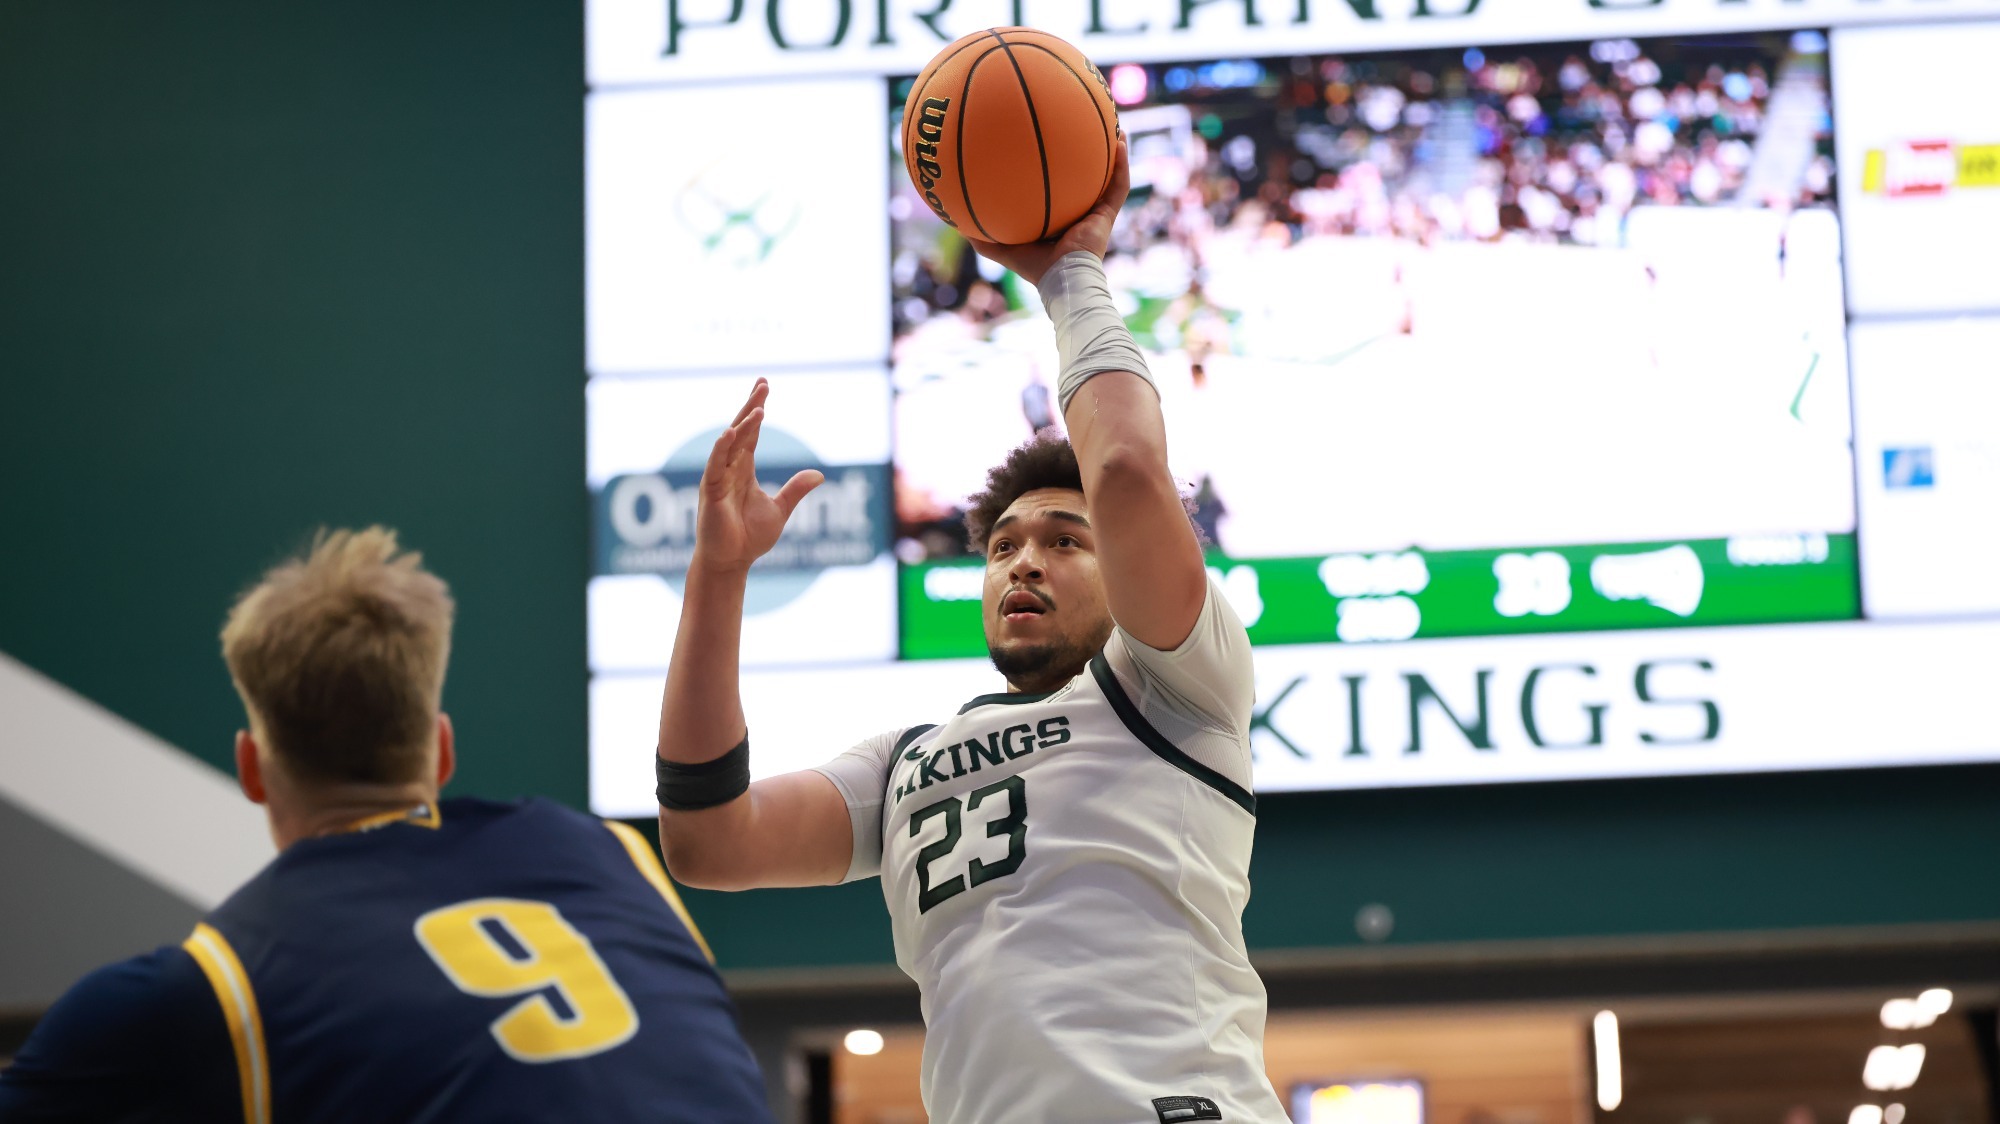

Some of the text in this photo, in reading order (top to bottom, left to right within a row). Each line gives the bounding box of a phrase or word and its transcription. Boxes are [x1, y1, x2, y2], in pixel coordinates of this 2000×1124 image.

[917, 96, 959, 228] Wilson
[911, 775, 1028, 915] 23
[414, 897, 639, 1063] 9
[1197, 1101, 1212, 1111] XL
